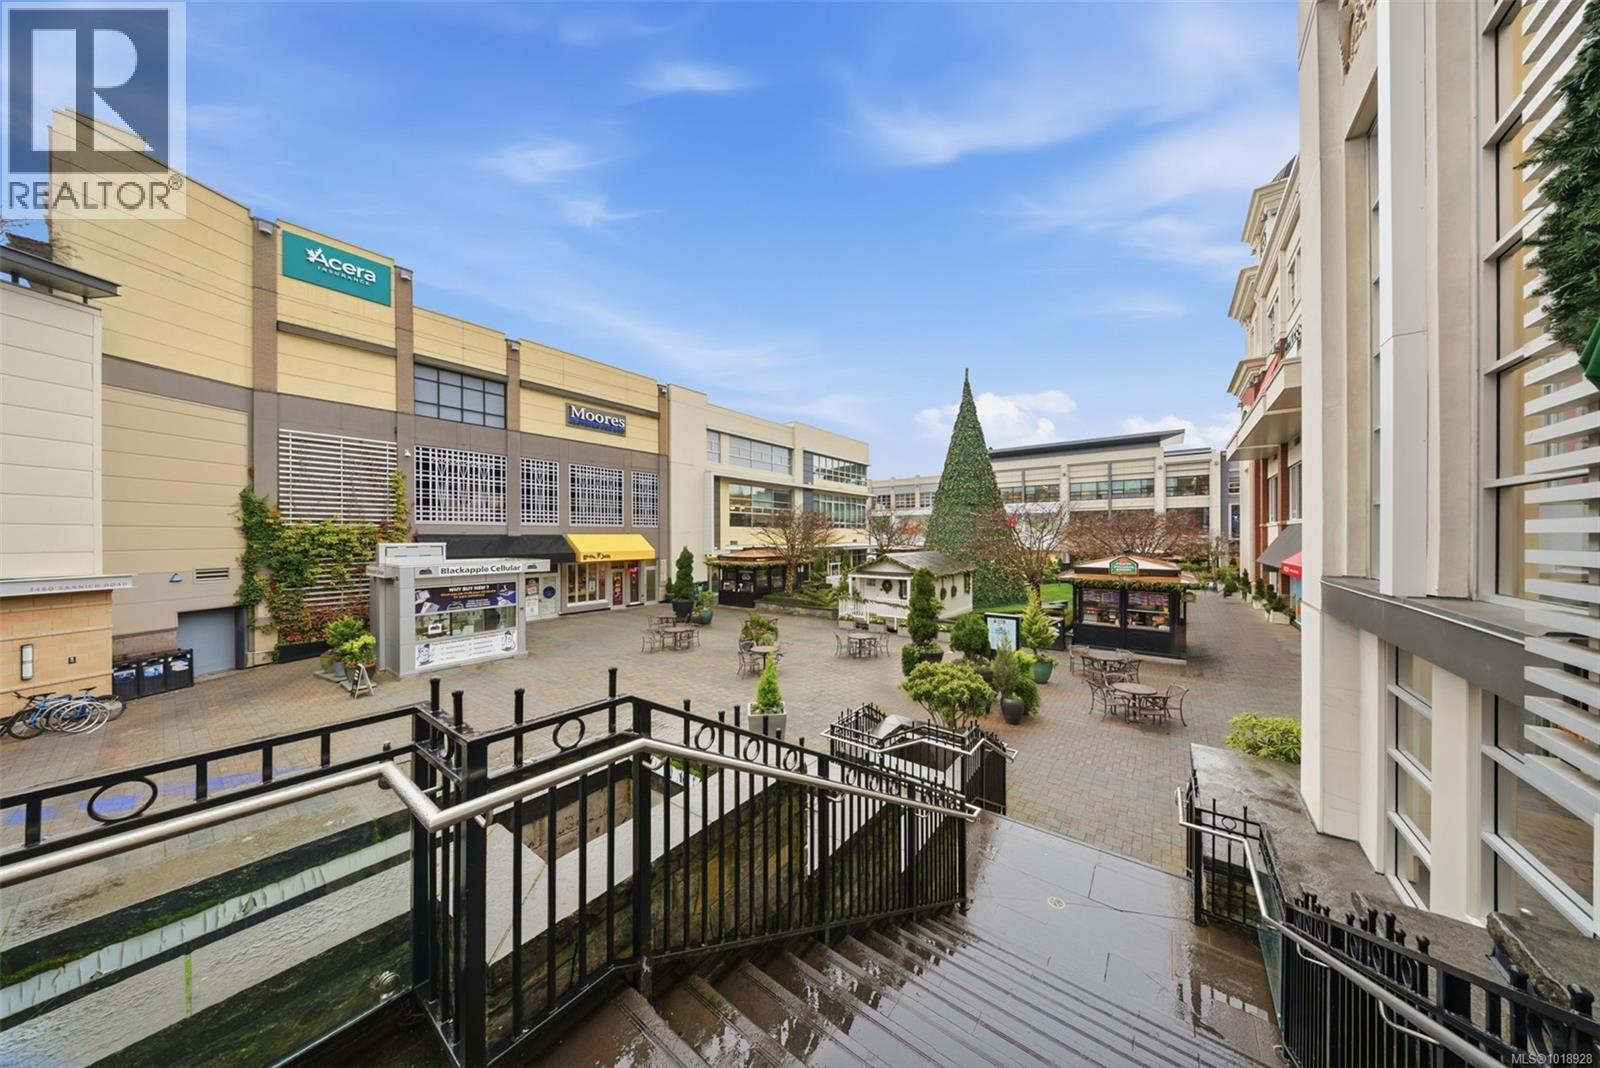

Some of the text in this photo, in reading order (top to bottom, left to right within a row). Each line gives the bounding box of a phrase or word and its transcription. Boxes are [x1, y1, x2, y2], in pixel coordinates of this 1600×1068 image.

[312, 252, 376, 283] Acera
[570, 405, 625, 428] Moores
[440, 564, 521, 575] Blackapple Cellular
